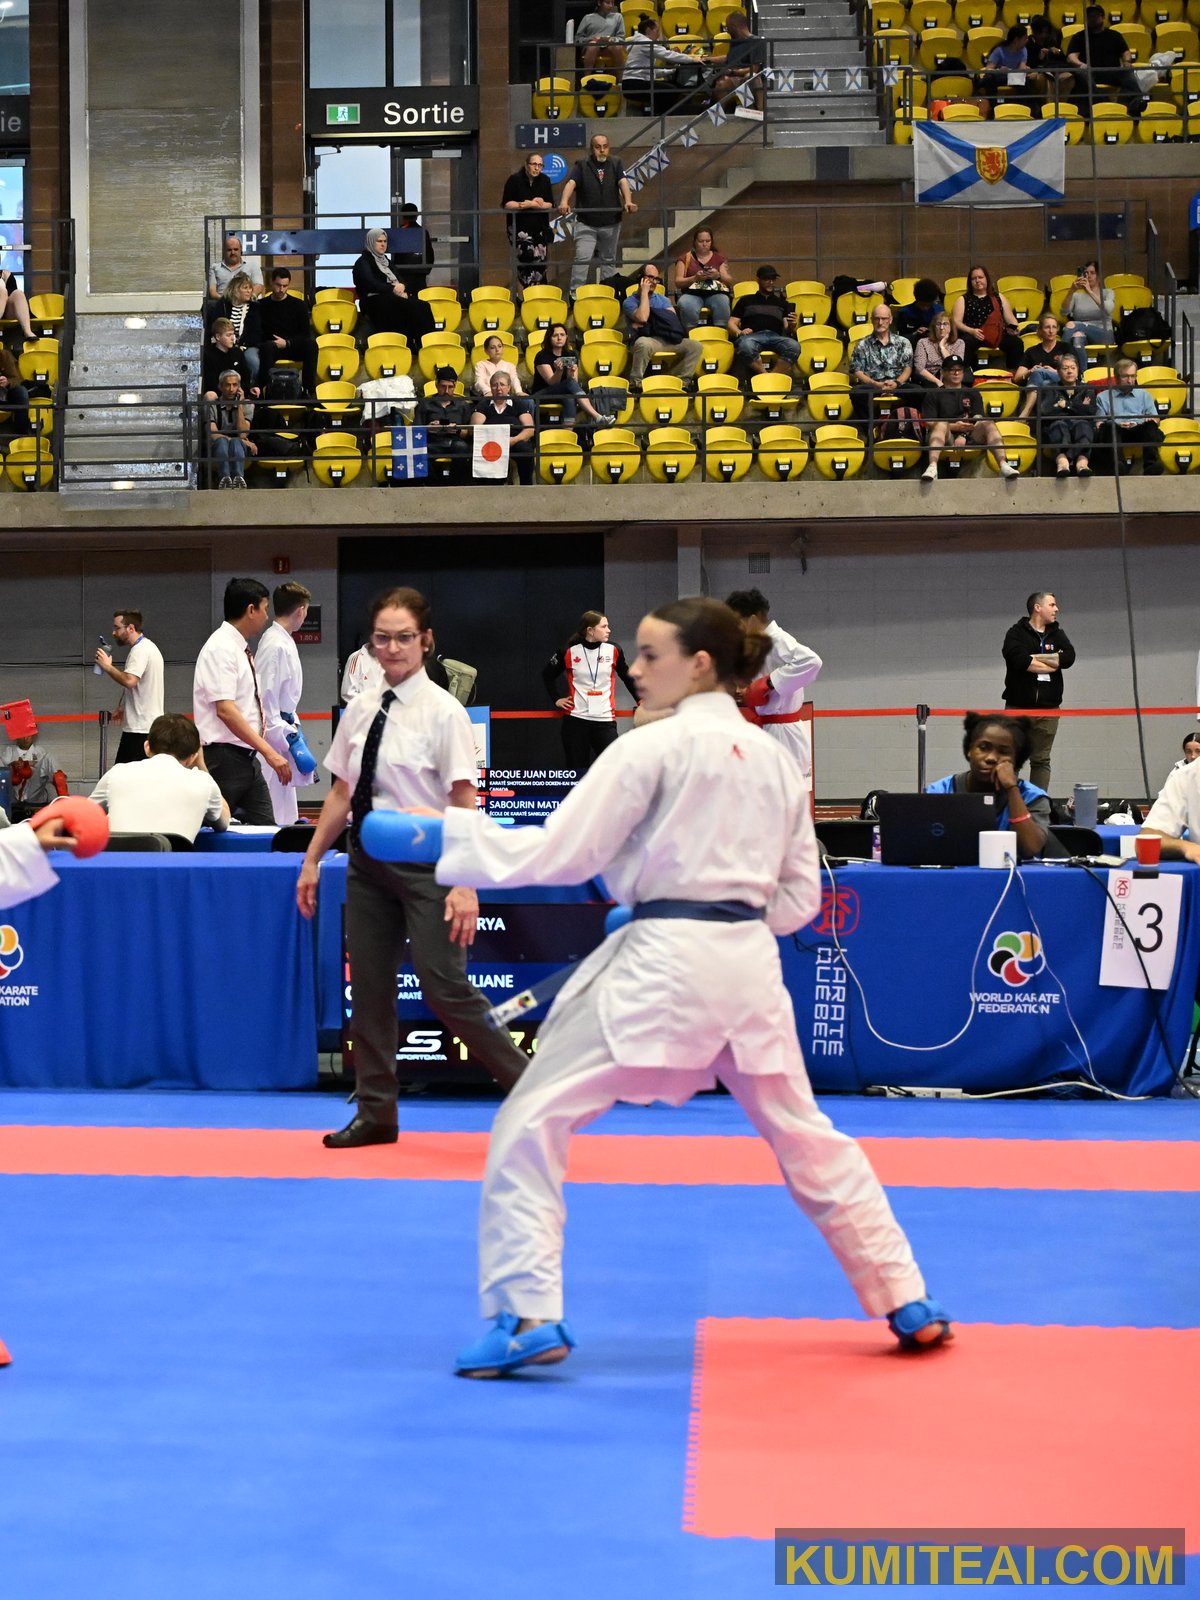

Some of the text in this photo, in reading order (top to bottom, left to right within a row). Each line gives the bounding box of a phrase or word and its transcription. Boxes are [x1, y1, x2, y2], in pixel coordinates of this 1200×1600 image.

[383, 101, 465, 125] Sortie
[490, 770, 577, 779] ROQUE JUAN DIEGO
[490, 800, 535, 809] SABOURIN
[1137, 902, 1163, 953] 3
[812, 947, 832, 1056] QUÉBEC
[828, 948, 848, 1057] KARATÉ
[969, 992, 1013, 1002] WORLD
